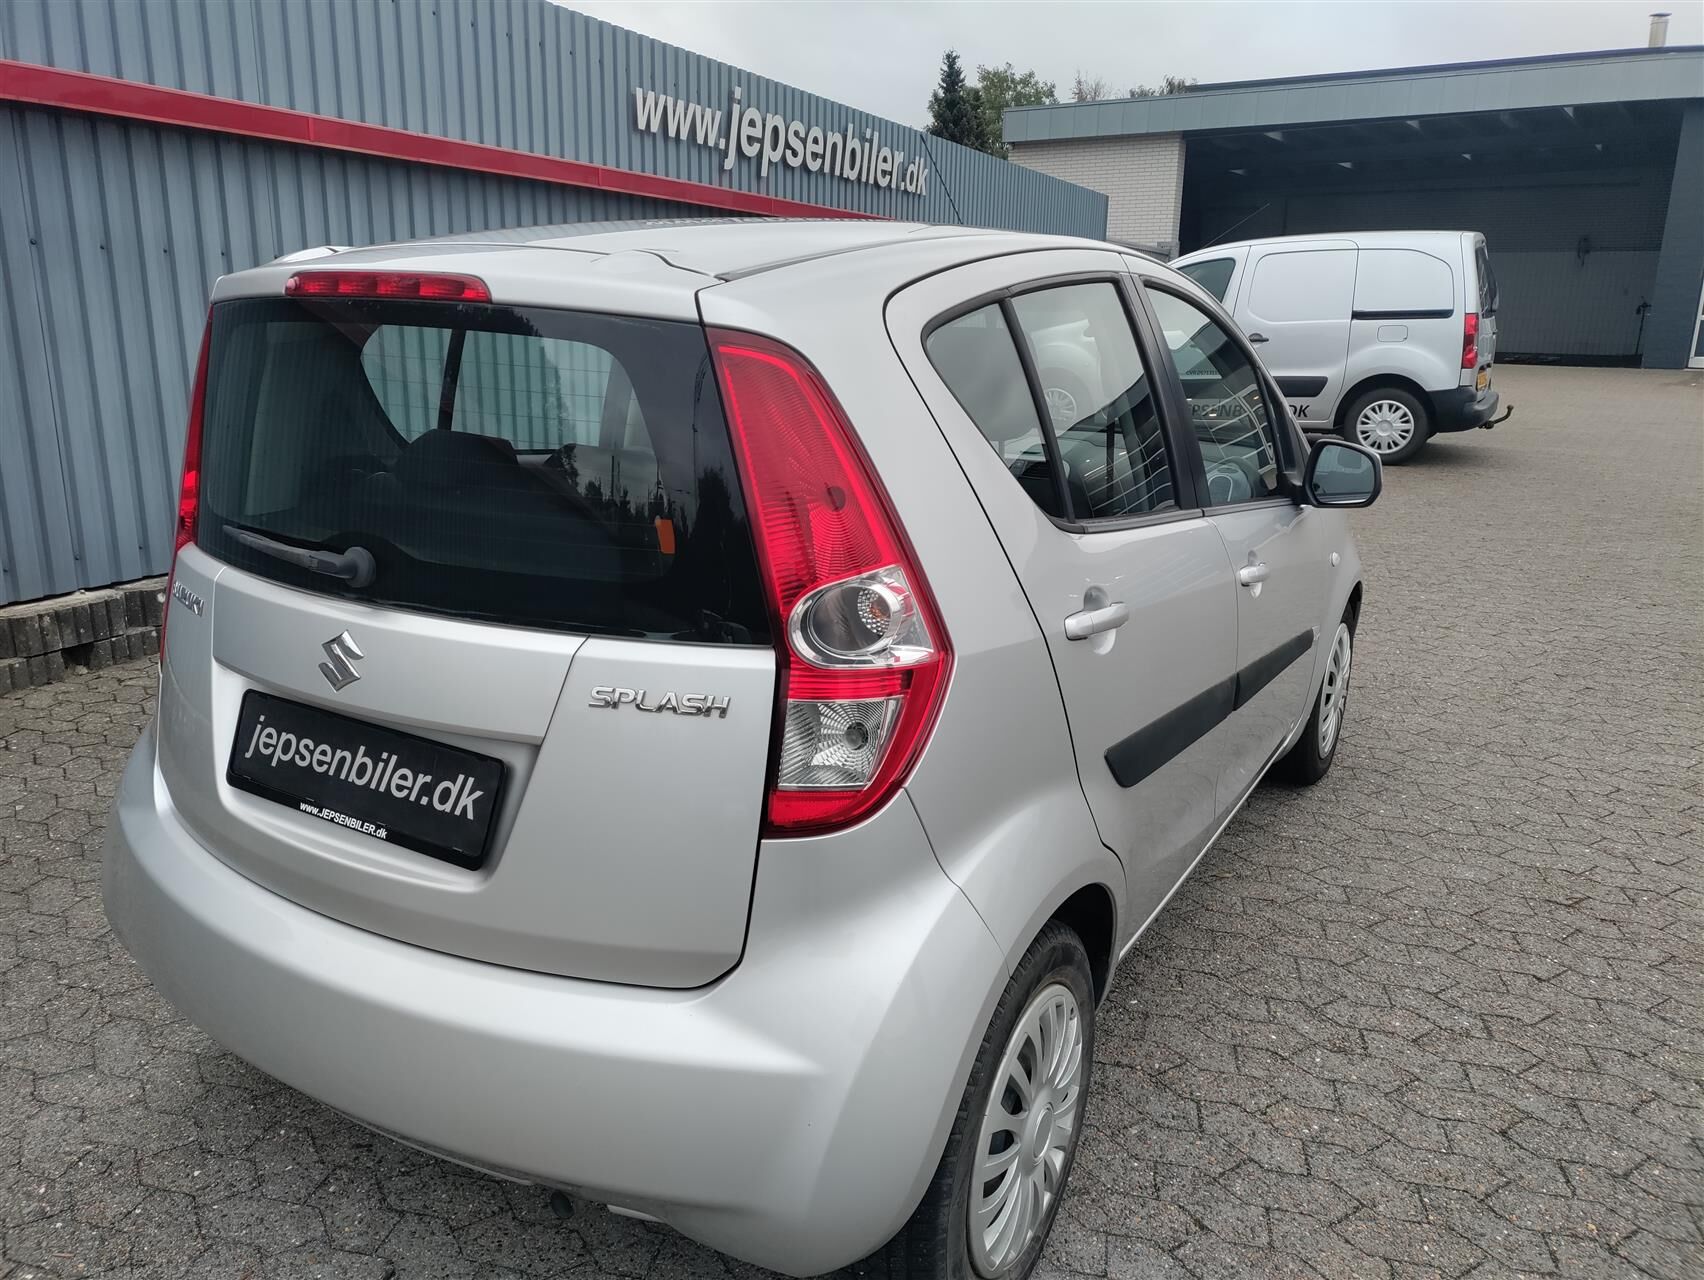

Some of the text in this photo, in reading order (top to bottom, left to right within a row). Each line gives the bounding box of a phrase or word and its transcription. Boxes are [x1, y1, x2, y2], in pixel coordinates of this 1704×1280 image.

[635, 86, 928, 196] www.jepsenbiler.dk
[588, 685, 731, 719] SPLASH
[244, 714, 484, 820] jepsenbiler.dk
[299, 802, 387, 840] www.JEPSENBILER.dk
